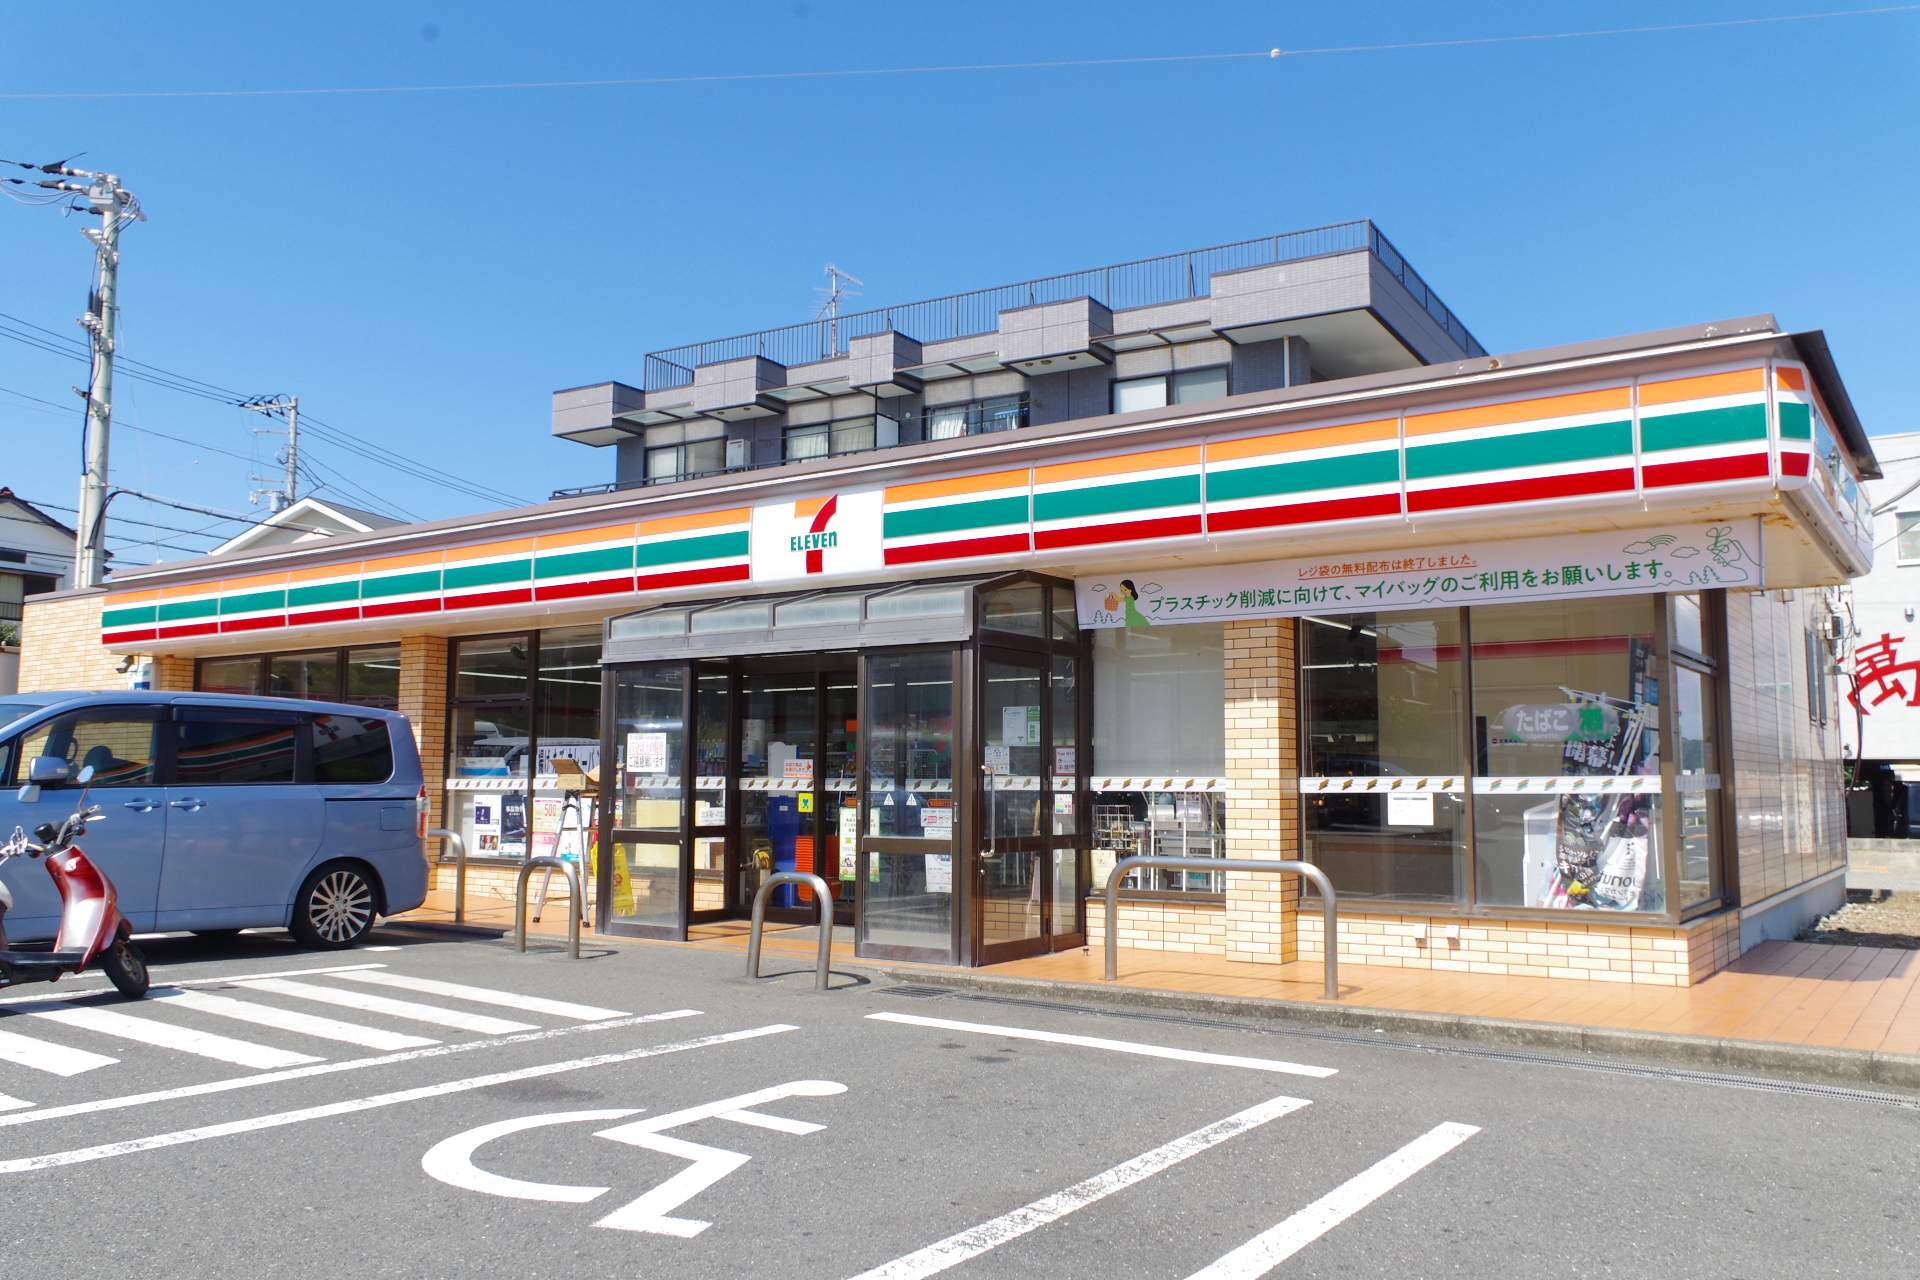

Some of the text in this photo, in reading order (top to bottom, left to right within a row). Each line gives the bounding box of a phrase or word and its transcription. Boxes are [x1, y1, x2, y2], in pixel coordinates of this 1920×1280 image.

[794, 494, 838, 574] 7
[1298, 553, 1478, 577] レジ袋の無料配布は終了しました。
[1149, 558, 1674, 614] プラスチック削減に向けて、マイバッグのご利用をお願いします。
[1516, 708, 1569, 732] たばこ
